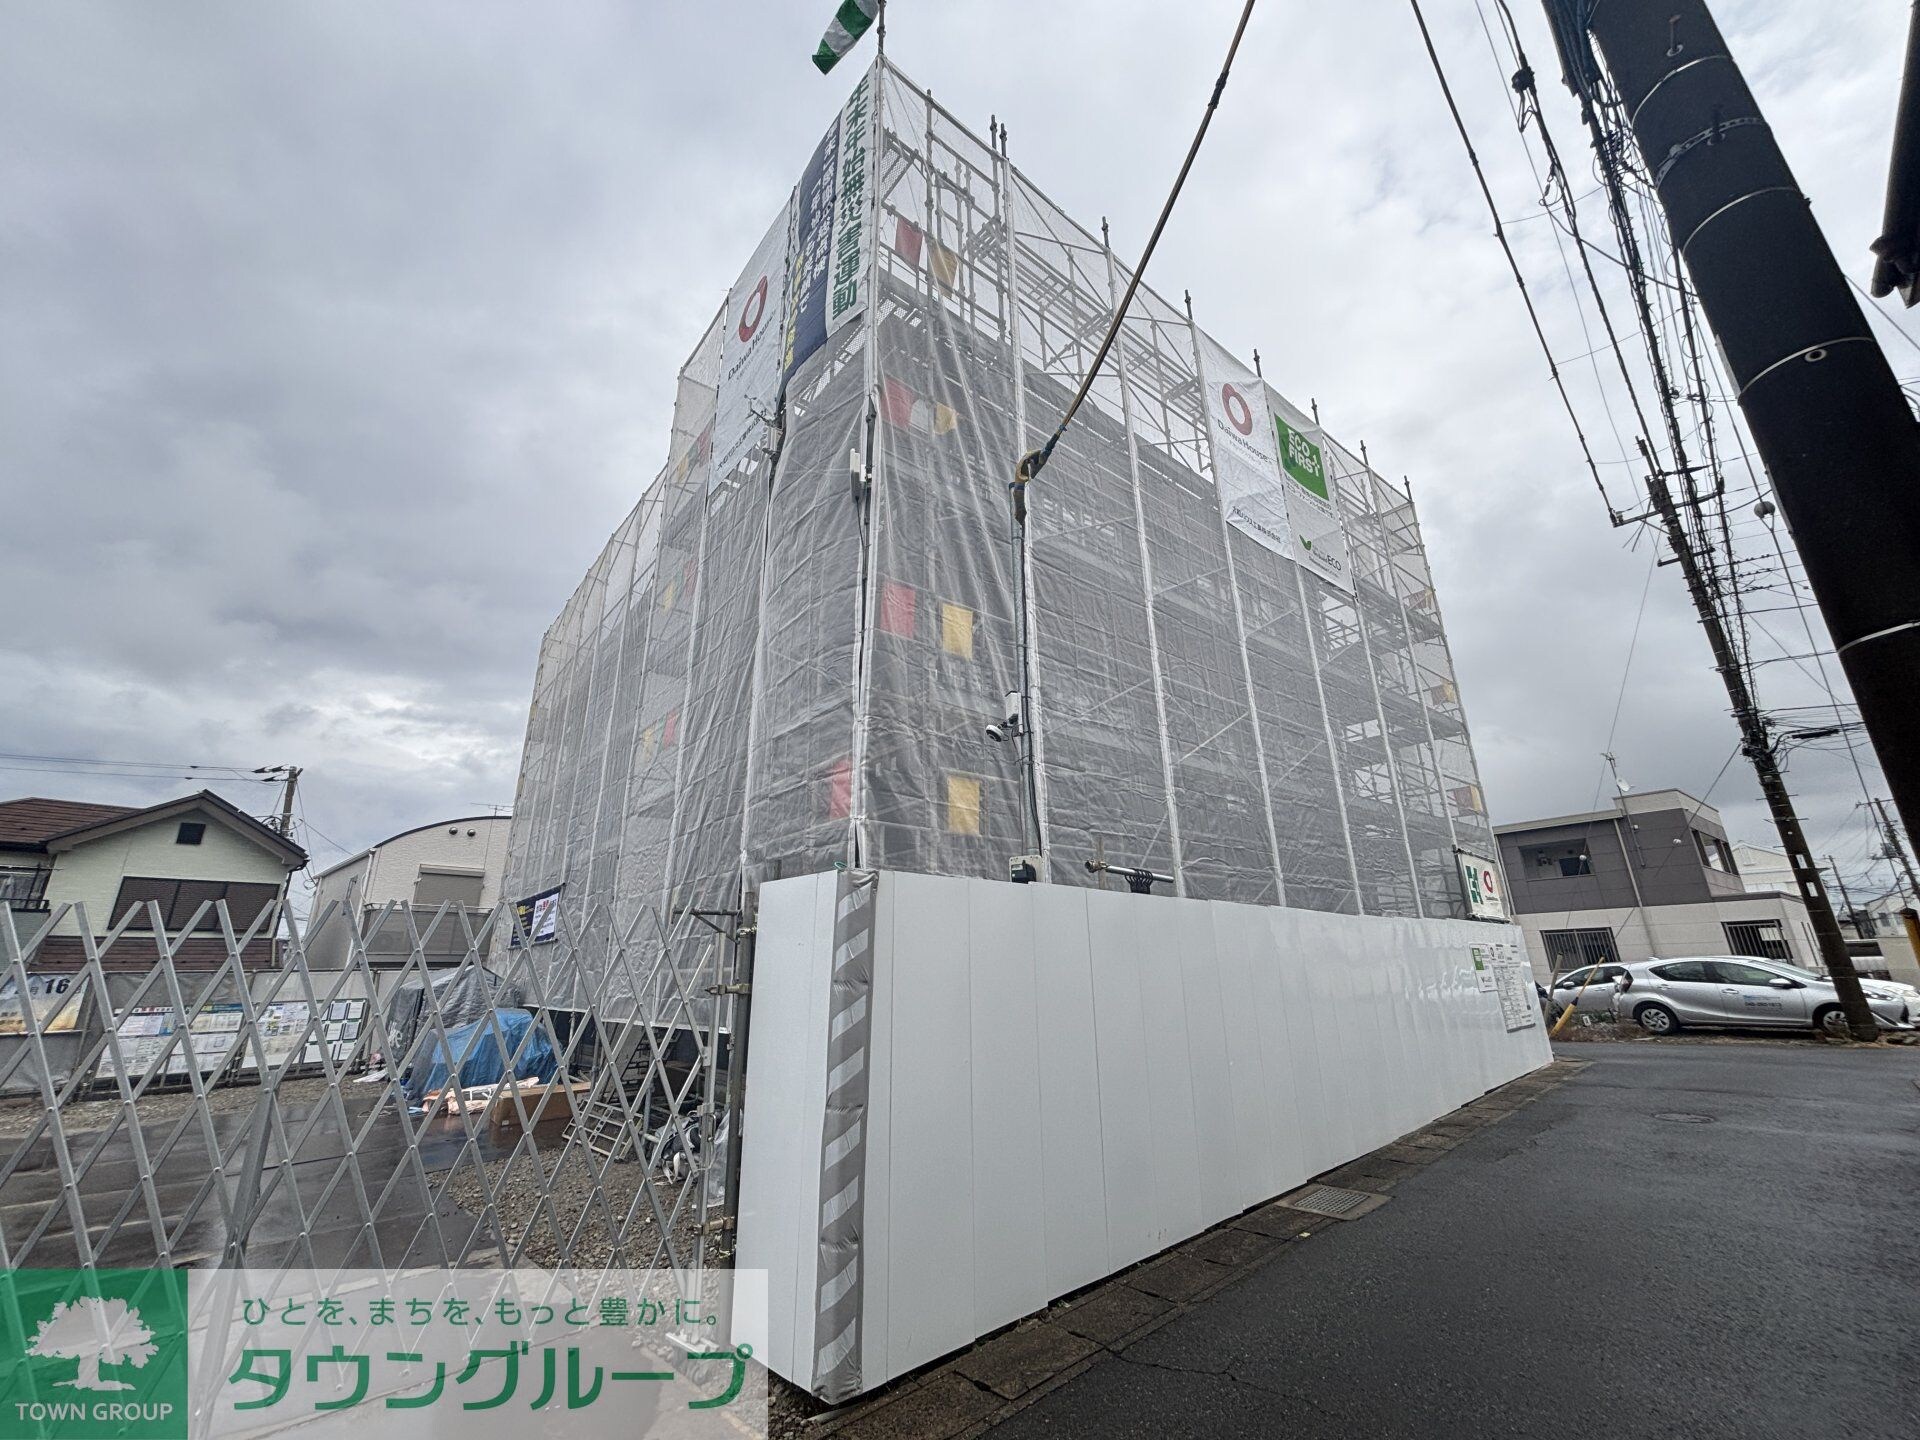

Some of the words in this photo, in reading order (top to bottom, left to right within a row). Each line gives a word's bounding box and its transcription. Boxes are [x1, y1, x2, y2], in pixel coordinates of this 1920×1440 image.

[832, 73, 869, 319] 年末年始無災害運動
[728, 346, 752, 381] Daiwa
[1217, 418, 1243, 449] Daiwa
[1243, 436, 1270, 463] House
[1287, 427, 1310, 458] ECO
[1289, 441, 1320, 477] FIRST
[45, 978, 71, 994] 16
